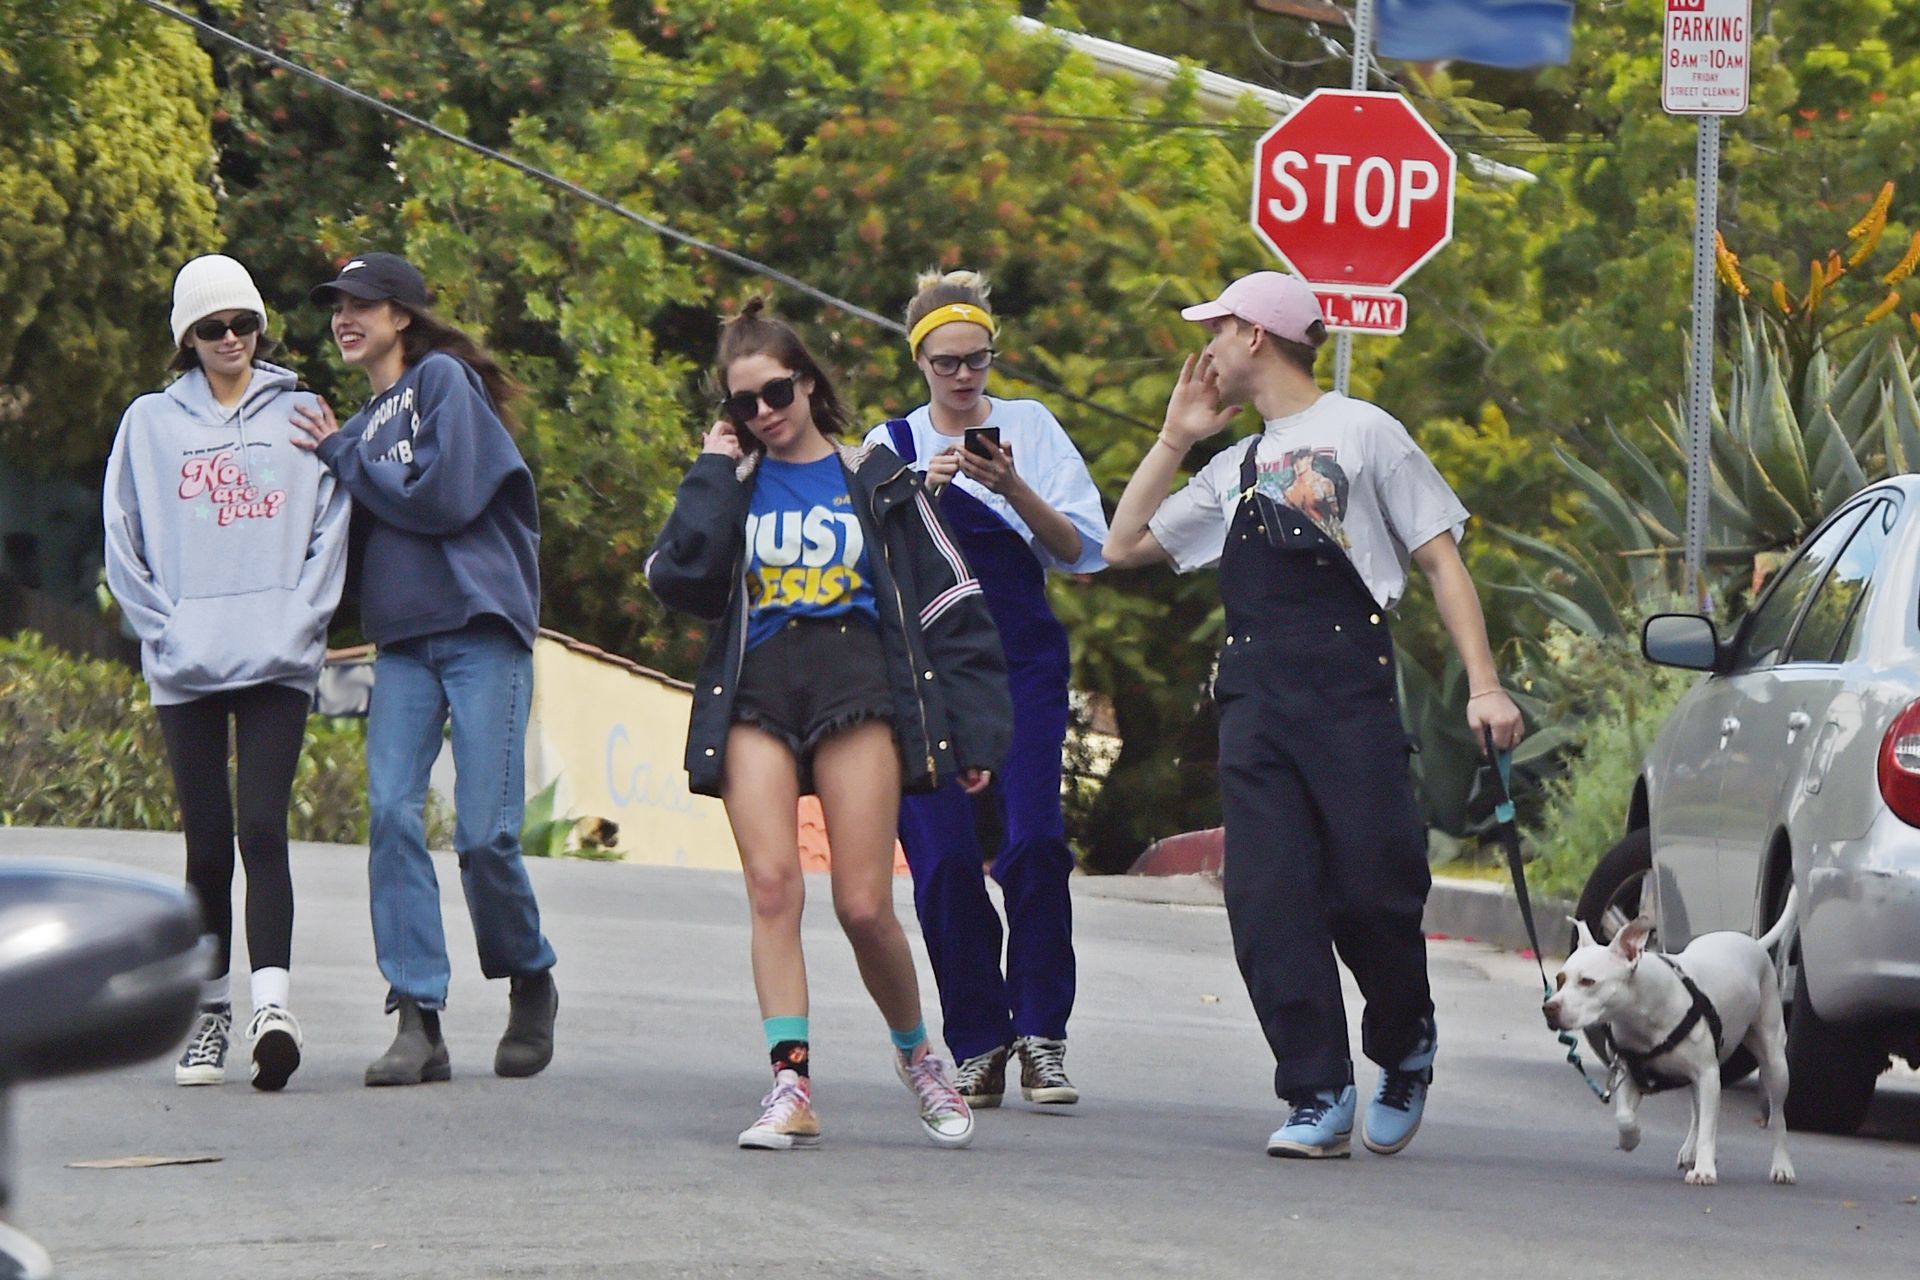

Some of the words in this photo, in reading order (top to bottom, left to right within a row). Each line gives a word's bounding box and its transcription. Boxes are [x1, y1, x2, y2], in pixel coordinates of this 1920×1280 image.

[1673, 16, 1743, 42] PARKING
[1692, 72, 1719, 81] FRIDAY
[1670, 86, 1698, 96] STREET
[1703, 87, 1740, 97] CLEANING
[1268, 150, 1440, 229] STOP
[1351, 299, 1396, 325] WAY
